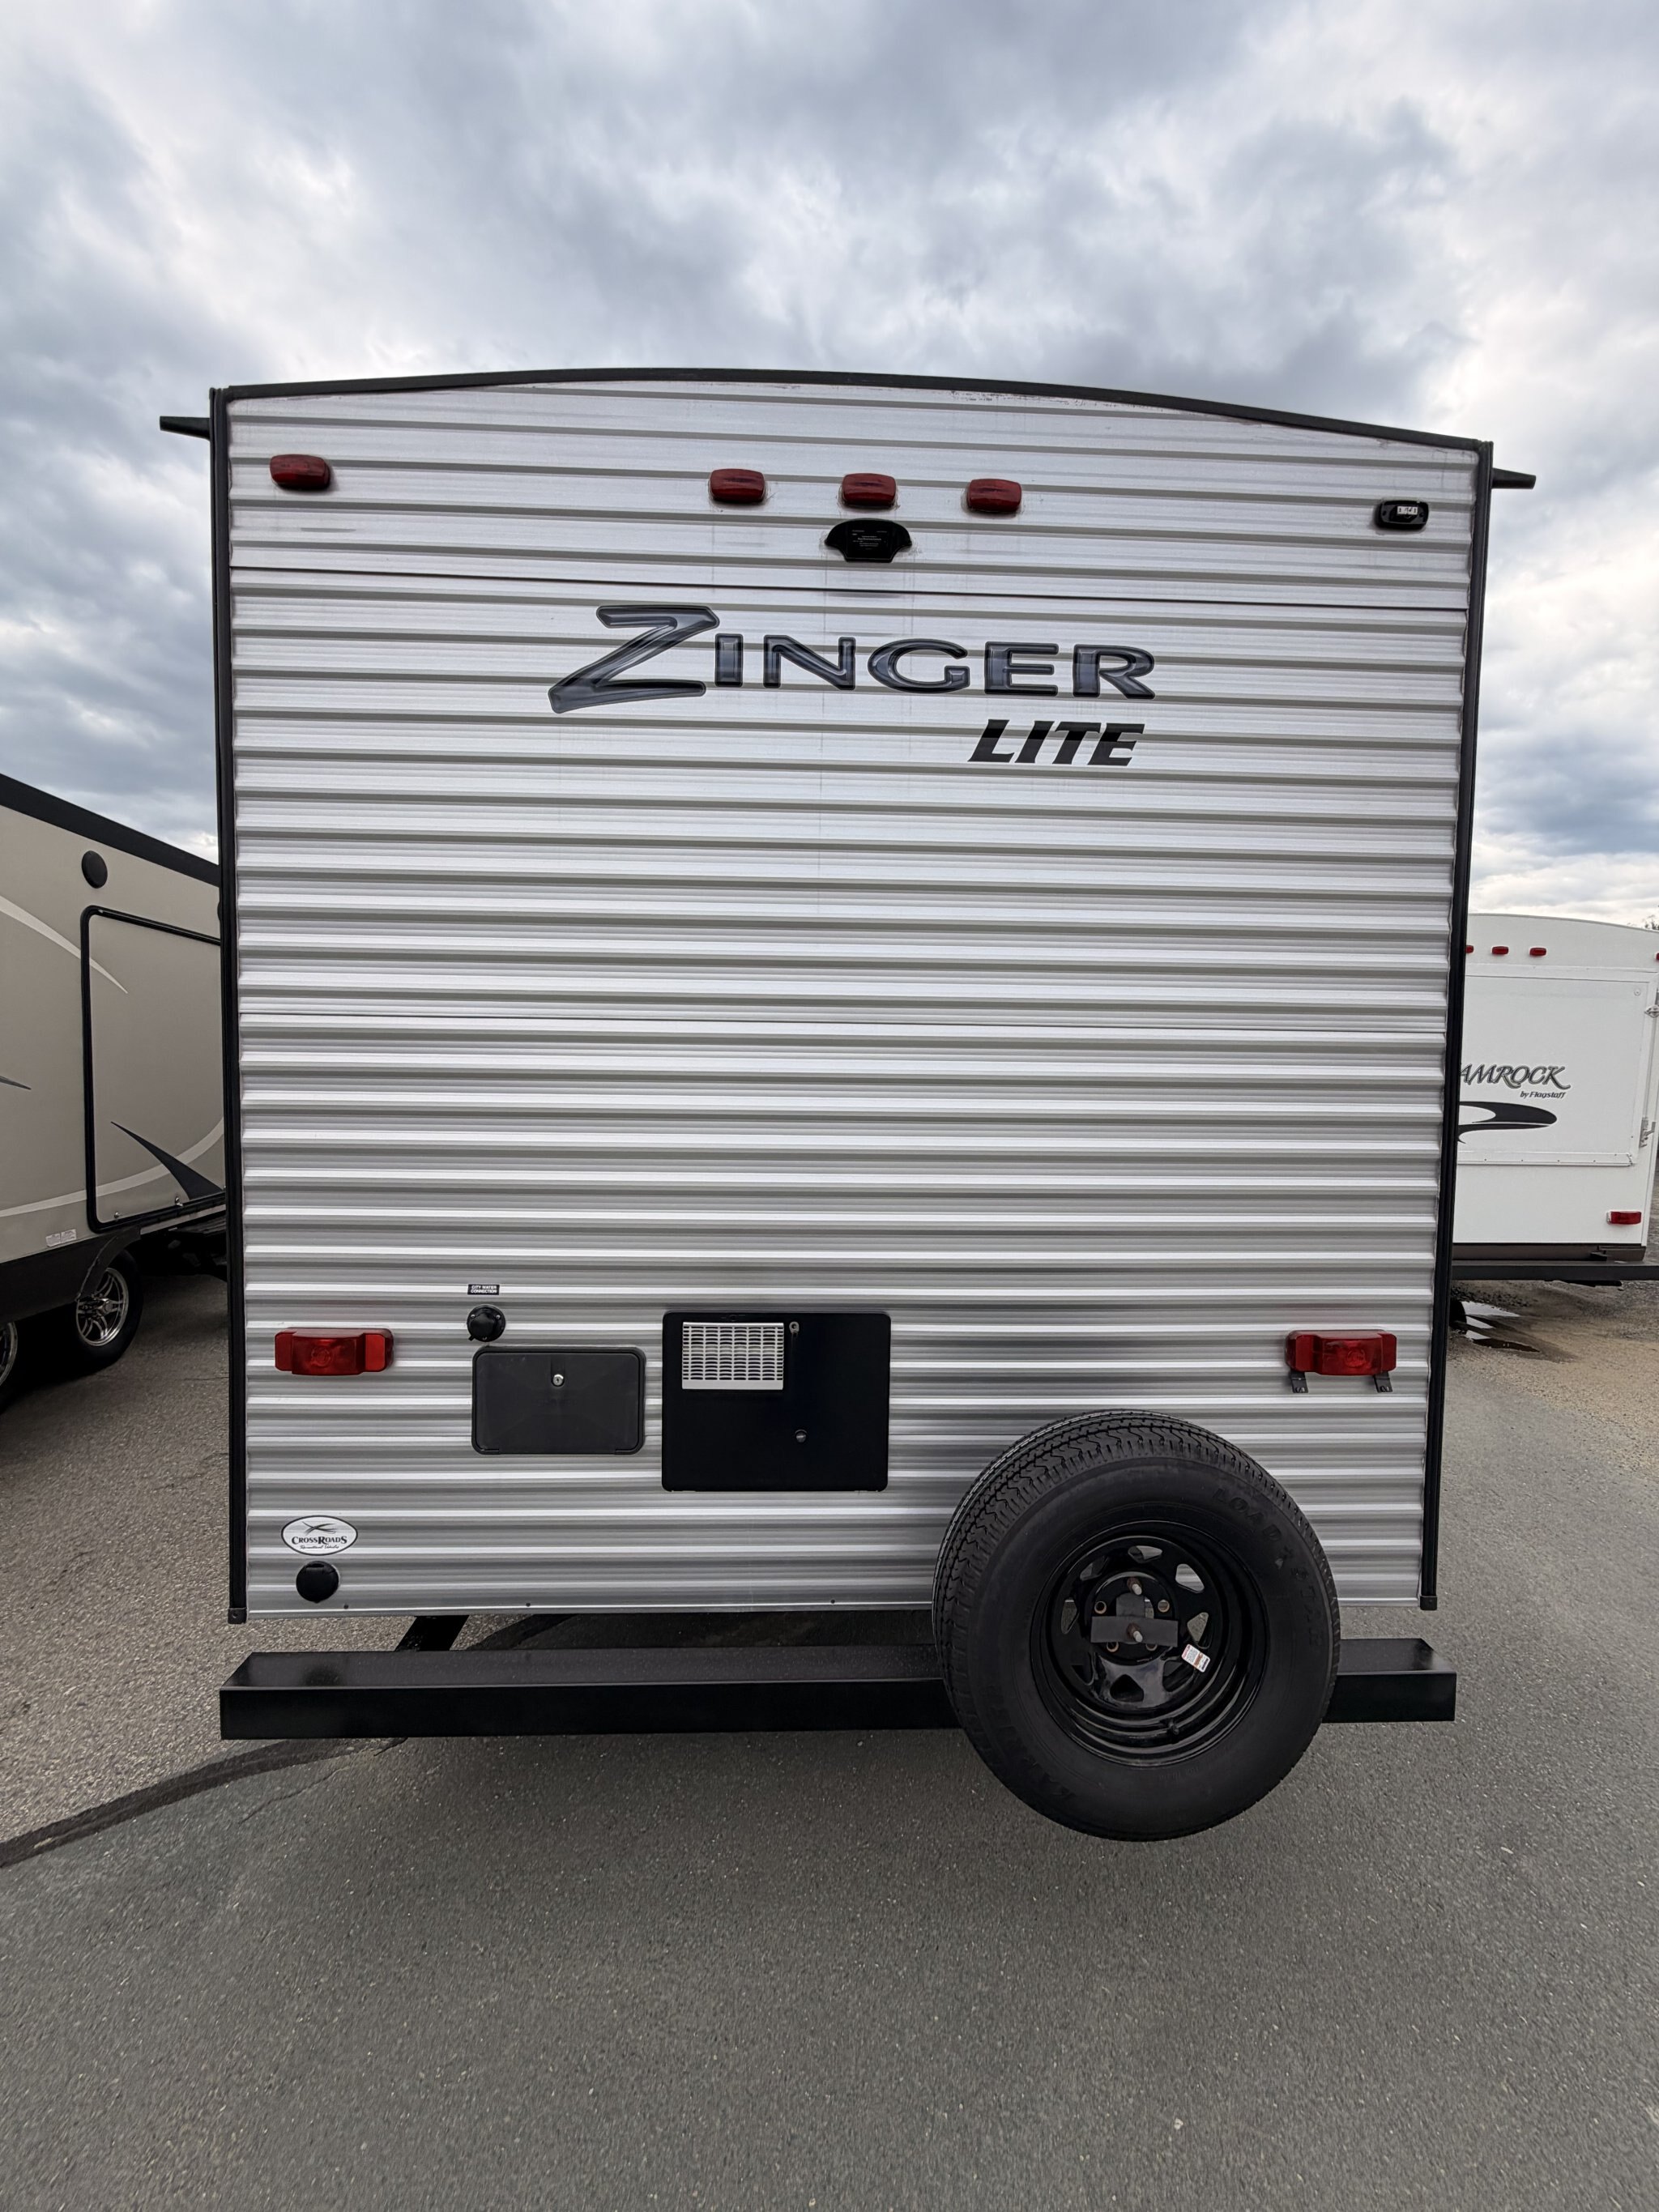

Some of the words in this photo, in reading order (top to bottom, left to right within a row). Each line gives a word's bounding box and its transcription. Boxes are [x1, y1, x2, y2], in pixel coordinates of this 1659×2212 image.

[548, 604, 1155, 714] ZINGER
[967, 718, 1145, 766] LITE
[1529, 1091, 1567, 1099] Flagstaff
